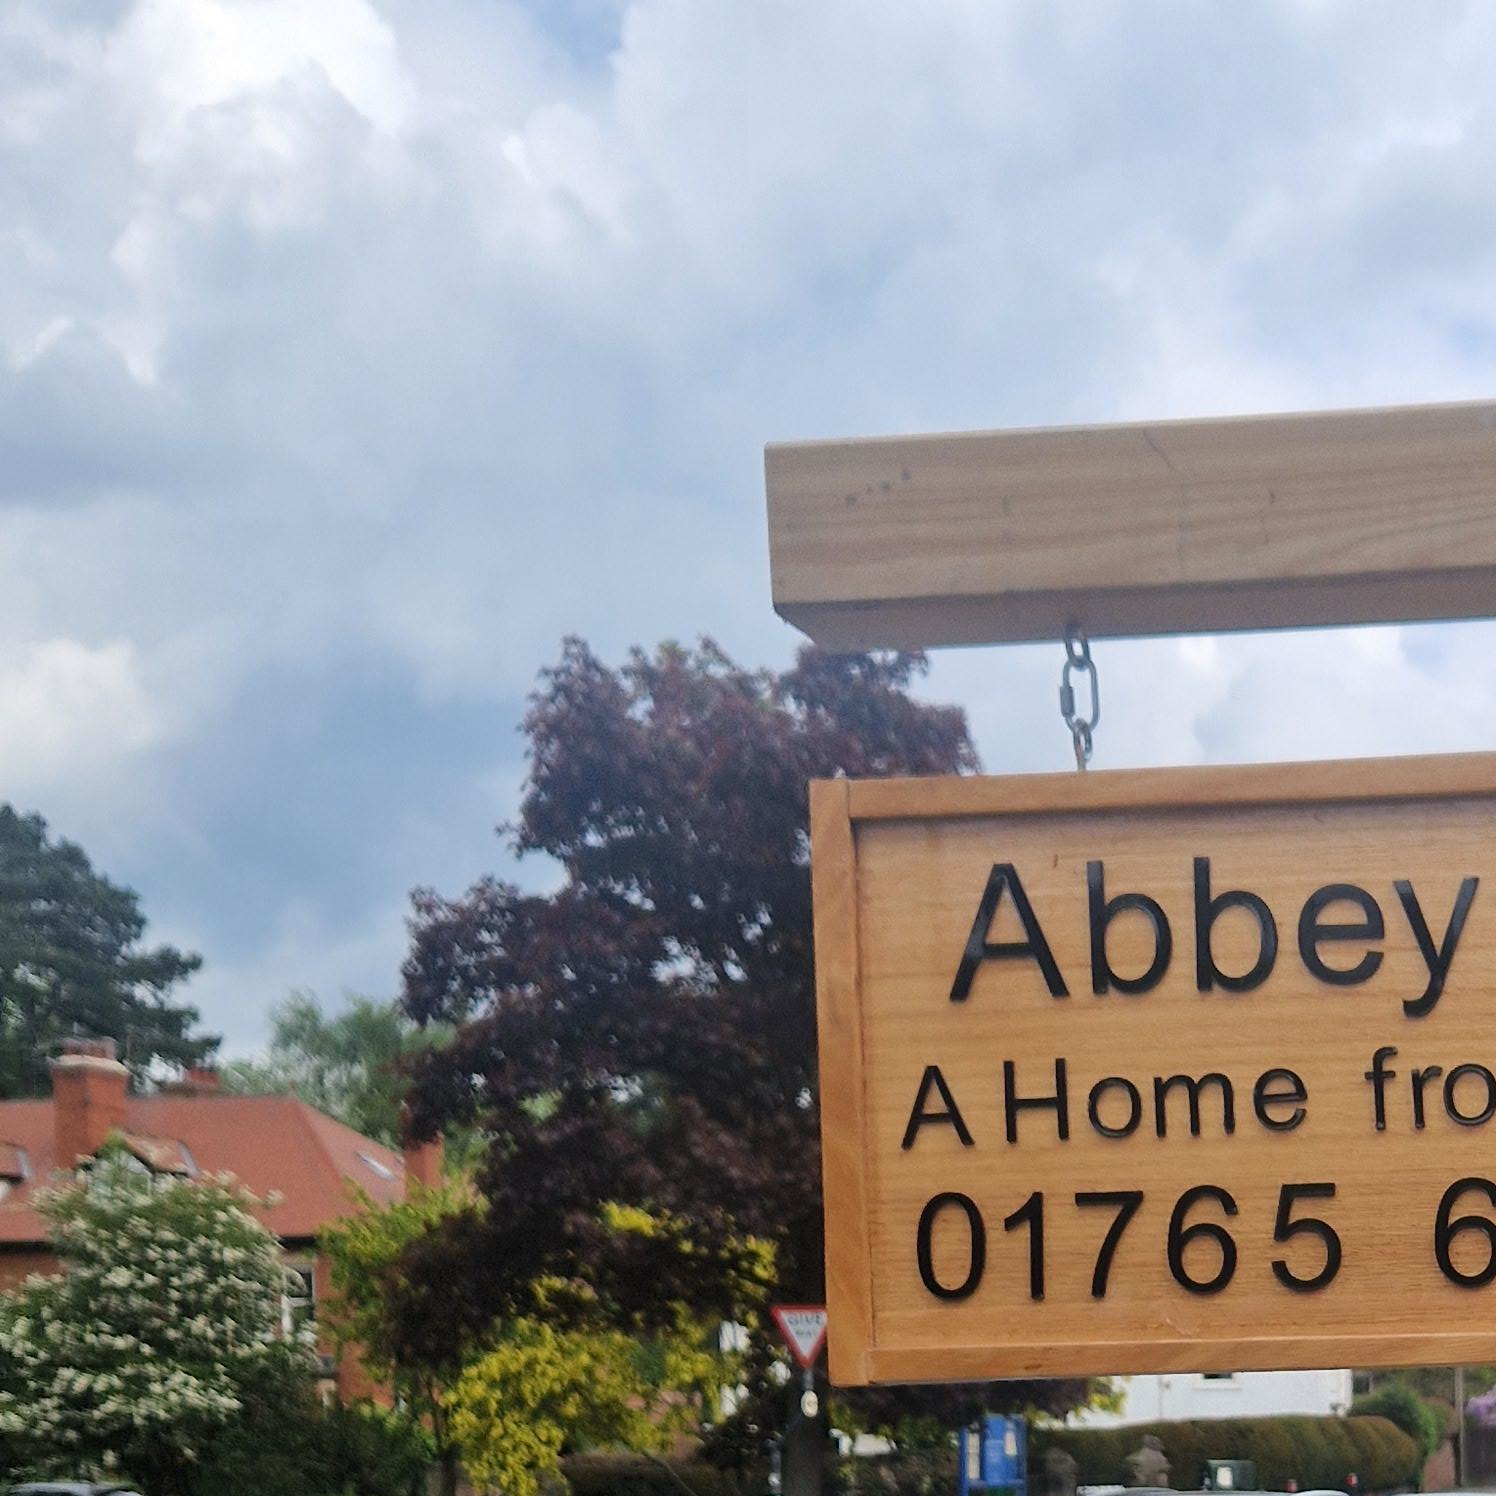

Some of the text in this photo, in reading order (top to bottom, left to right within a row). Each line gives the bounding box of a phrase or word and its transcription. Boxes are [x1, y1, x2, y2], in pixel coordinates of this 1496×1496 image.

[901, 1065, 975, 1151] A
[1004, 1057, 1308, 1146] Home
[915, 1182, 1345, 1306] 01765
